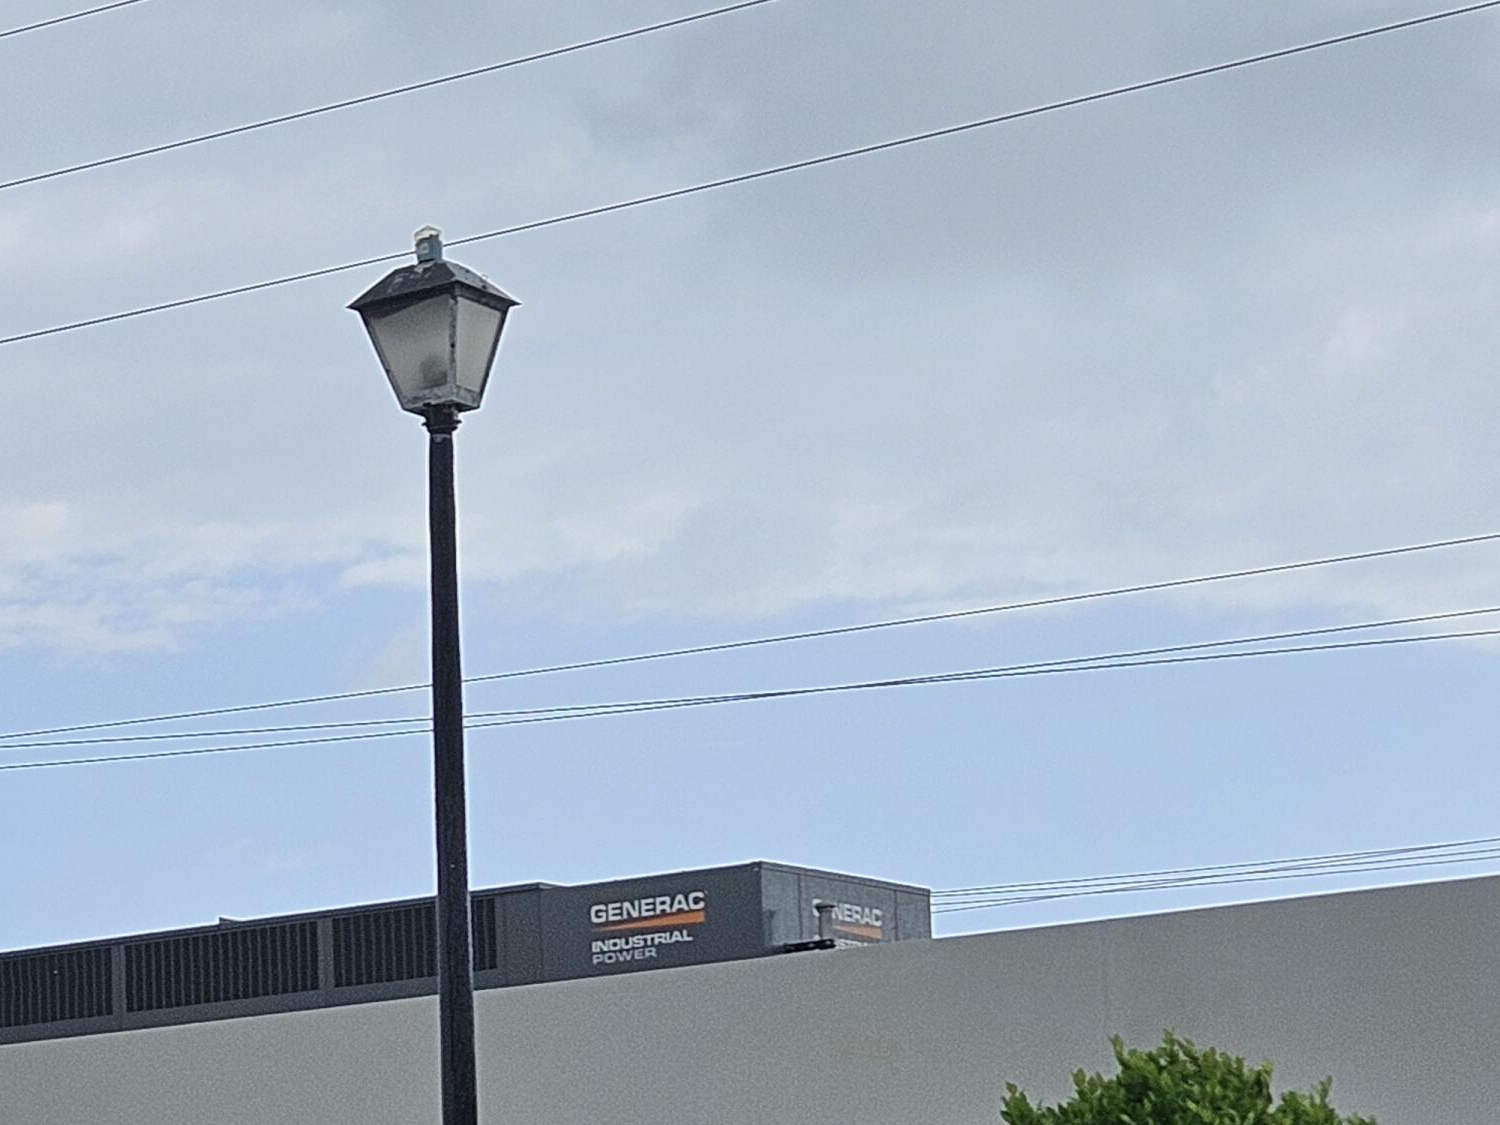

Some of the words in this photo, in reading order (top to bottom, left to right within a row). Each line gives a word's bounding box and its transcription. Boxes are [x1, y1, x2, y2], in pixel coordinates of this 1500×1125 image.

[590, 891, 705, 923] GENERAC
[592, 930, 693, 953] INDUSTRIAL
[592, 947, 657, 965] POWER
